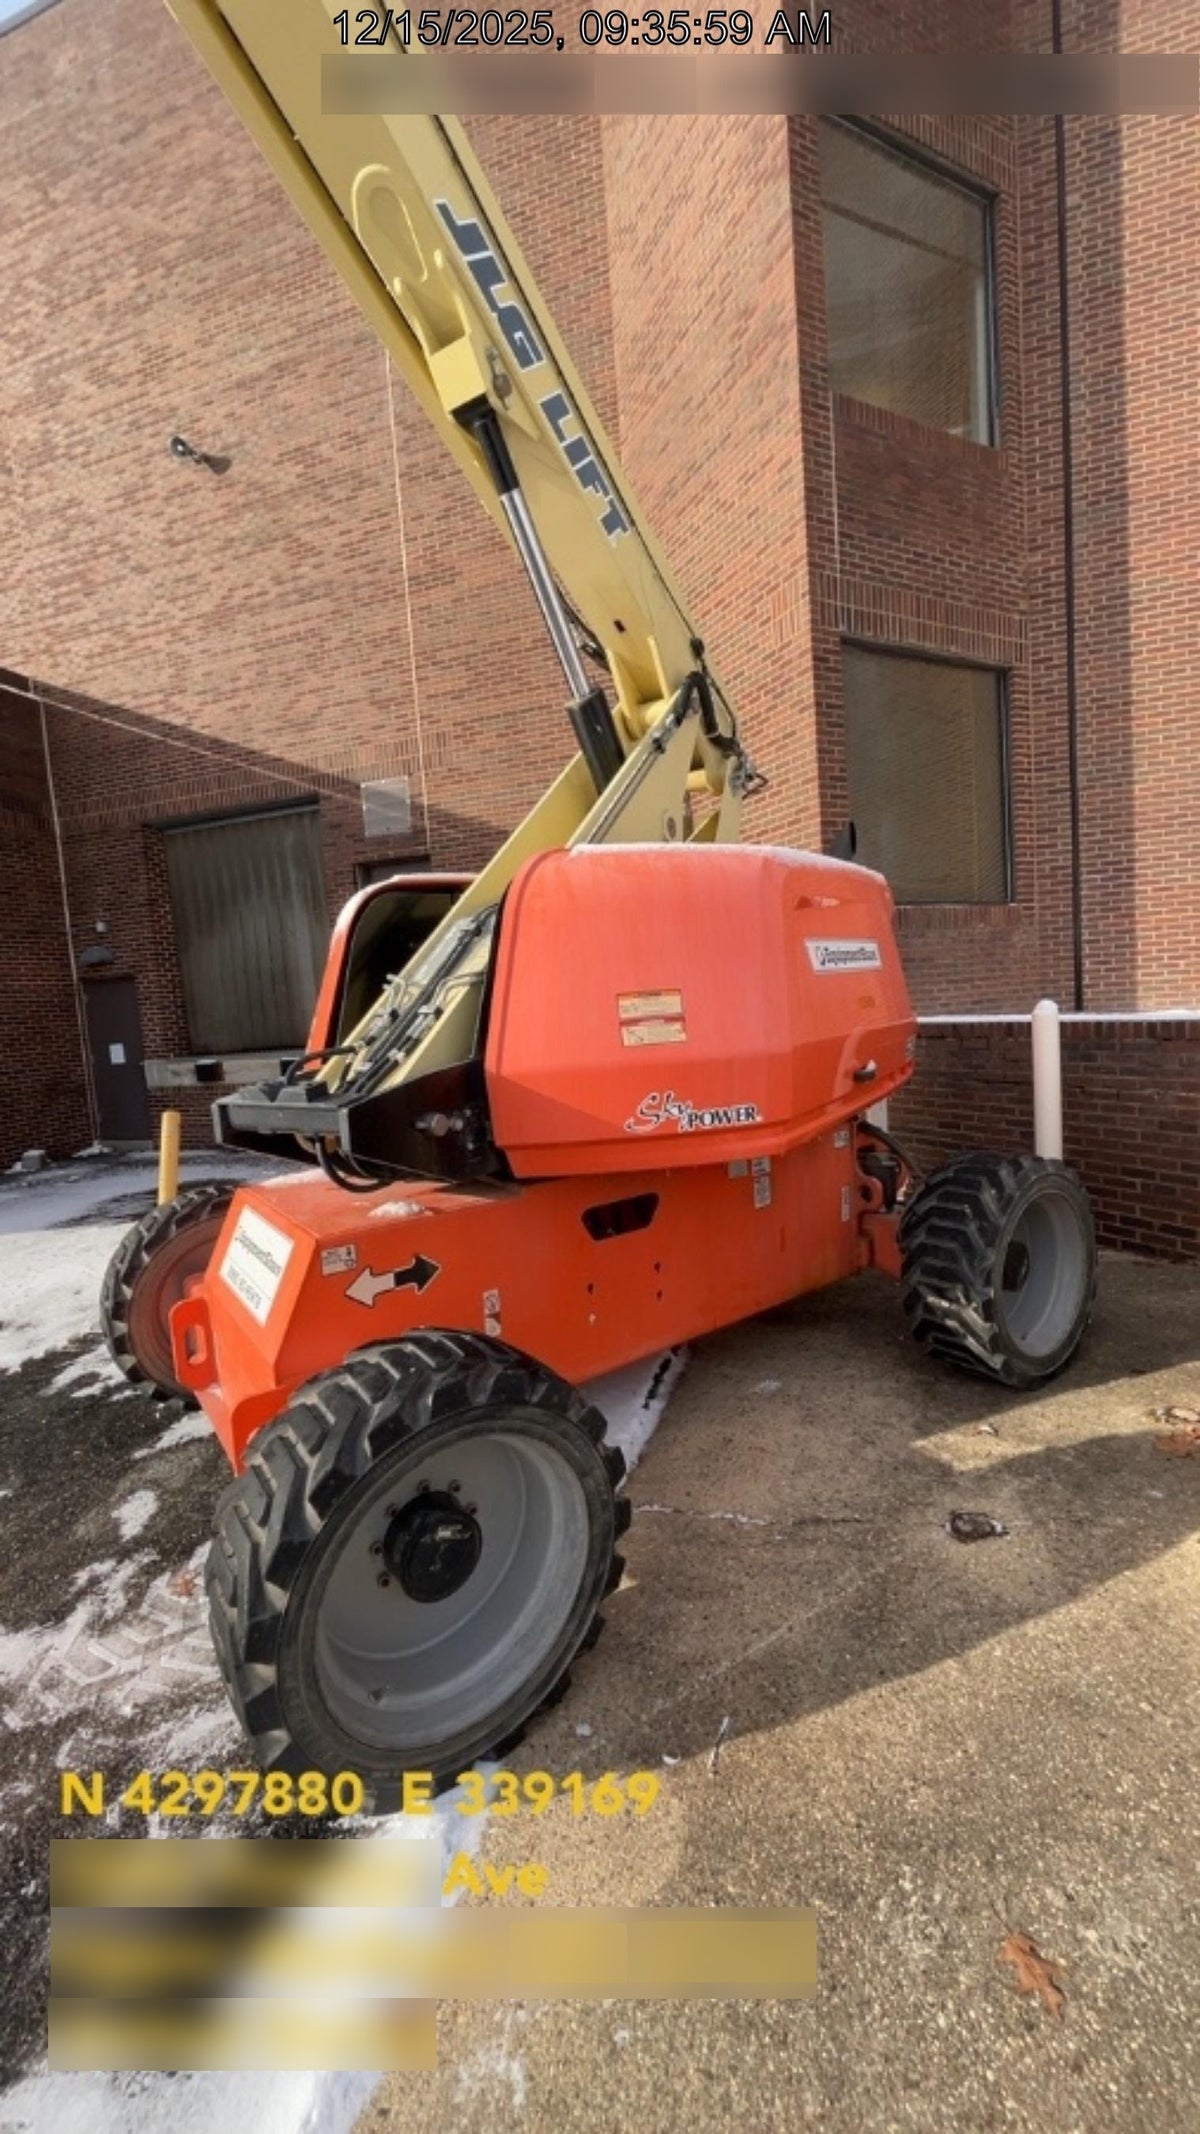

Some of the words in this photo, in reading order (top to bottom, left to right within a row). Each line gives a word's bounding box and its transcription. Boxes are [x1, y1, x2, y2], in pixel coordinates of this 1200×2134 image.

[433, 199, 546, 373] JLG
[538, 391, 632, 542] LIFT
[684, 1104, 761, 1131] POWER
